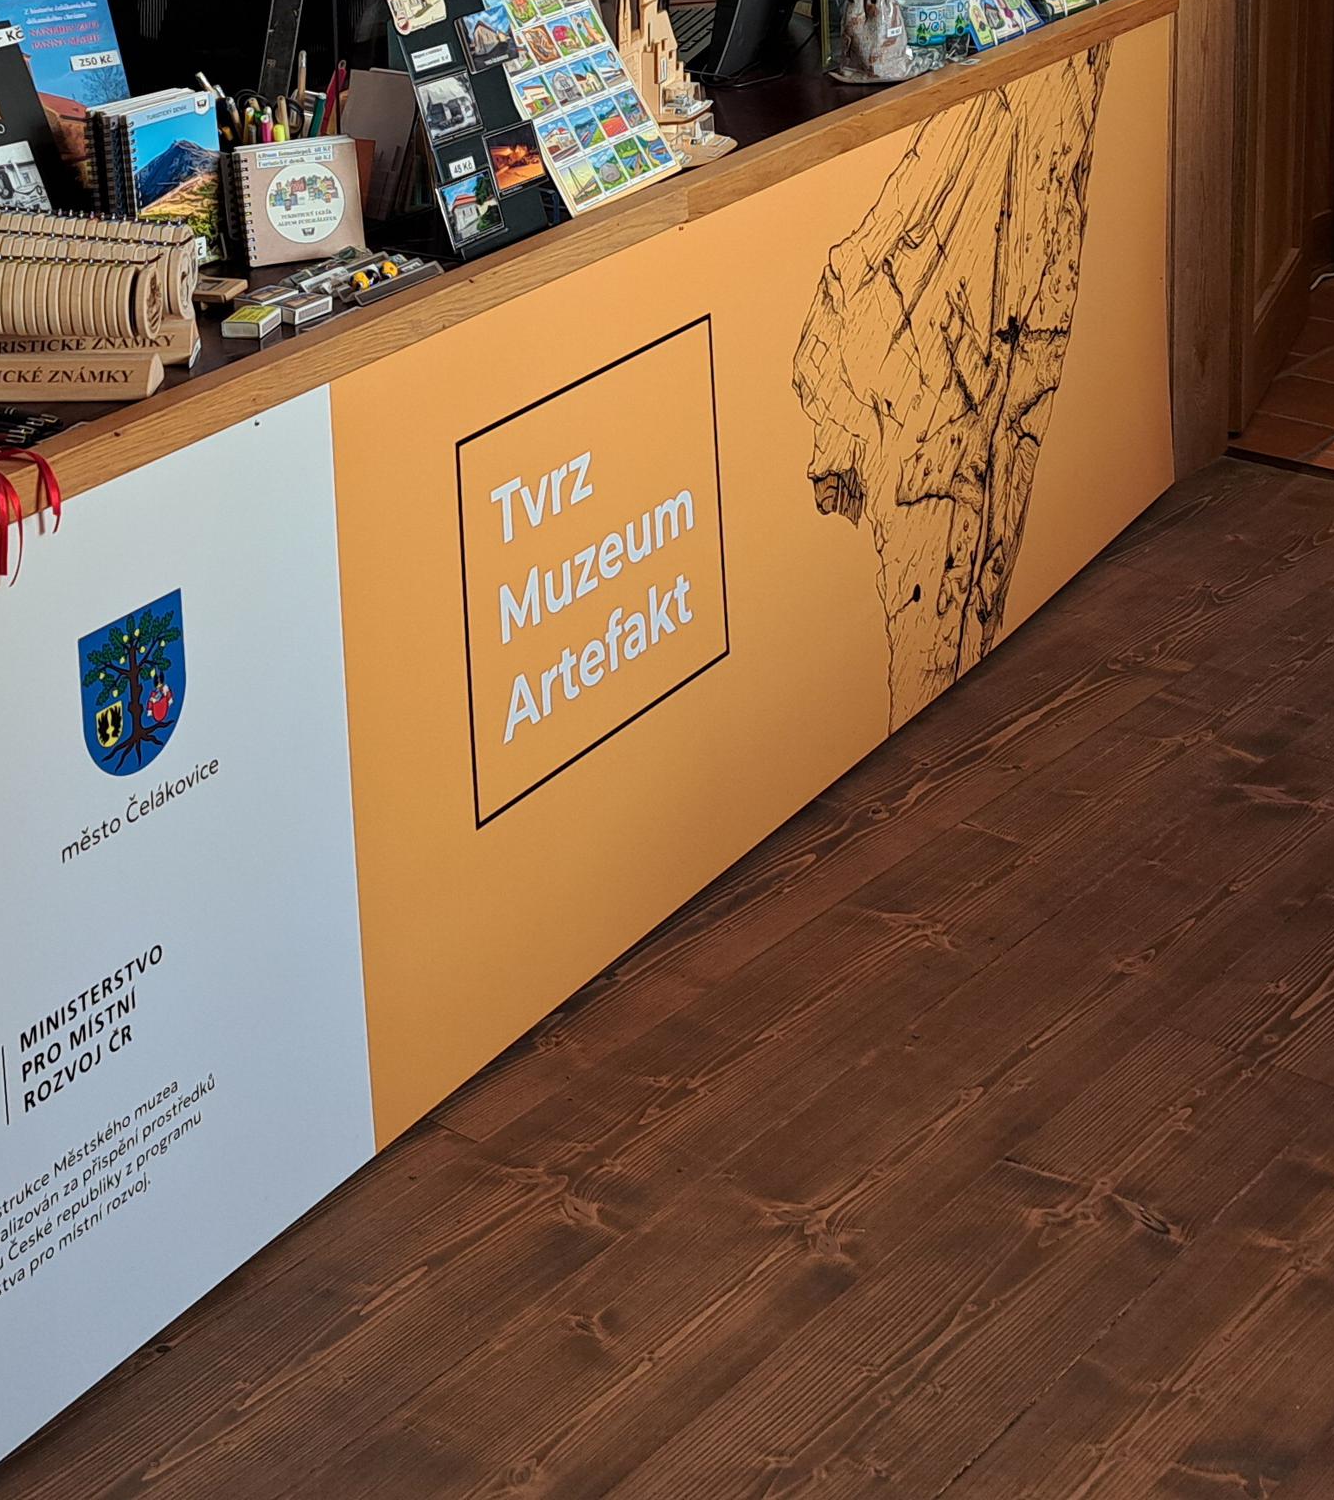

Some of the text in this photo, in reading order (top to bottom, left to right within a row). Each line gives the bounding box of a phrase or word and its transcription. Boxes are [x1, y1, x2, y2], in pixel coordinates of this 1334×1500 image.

[5, 25, 25, 41] Kč
[79, 54, 113, 67] 250 Kč
[48, 366, 135, 385] ZNÁMKY
[489, 450, 594, 544] Tvrz
[498, 487, 696, 645] Muzeum
[501, 573, 694, 746] Artefakt
[60, 757, 220, 864] město Čelákovice
[19, 943, 165, 1053] MINISTERSTVO
[20, 986, 138, 1083] PRO MÍSTNÍ
[23, 1024, 134, 1113] ROZVOJ ČR
[53, 1114, 131, 1178] Městského
[134, 1081, 179, 1121] muzea
[63, 1177, 79, 1197] za
[83, 1127, 140, 1187] přispění
[142, 1073, 216, 1141] prostředků
[8, 1218, 53, 1262] České
[56, 1168, 123, 1228] republiky
[125, 1161, 133, 1177] z
[136, 1111, 203, 1171] programu
[30, 1245, 55, 1277] pro
[58, 1204, 103, 1251] místní
[106, 1172, 152, 1216] rozvoj.
